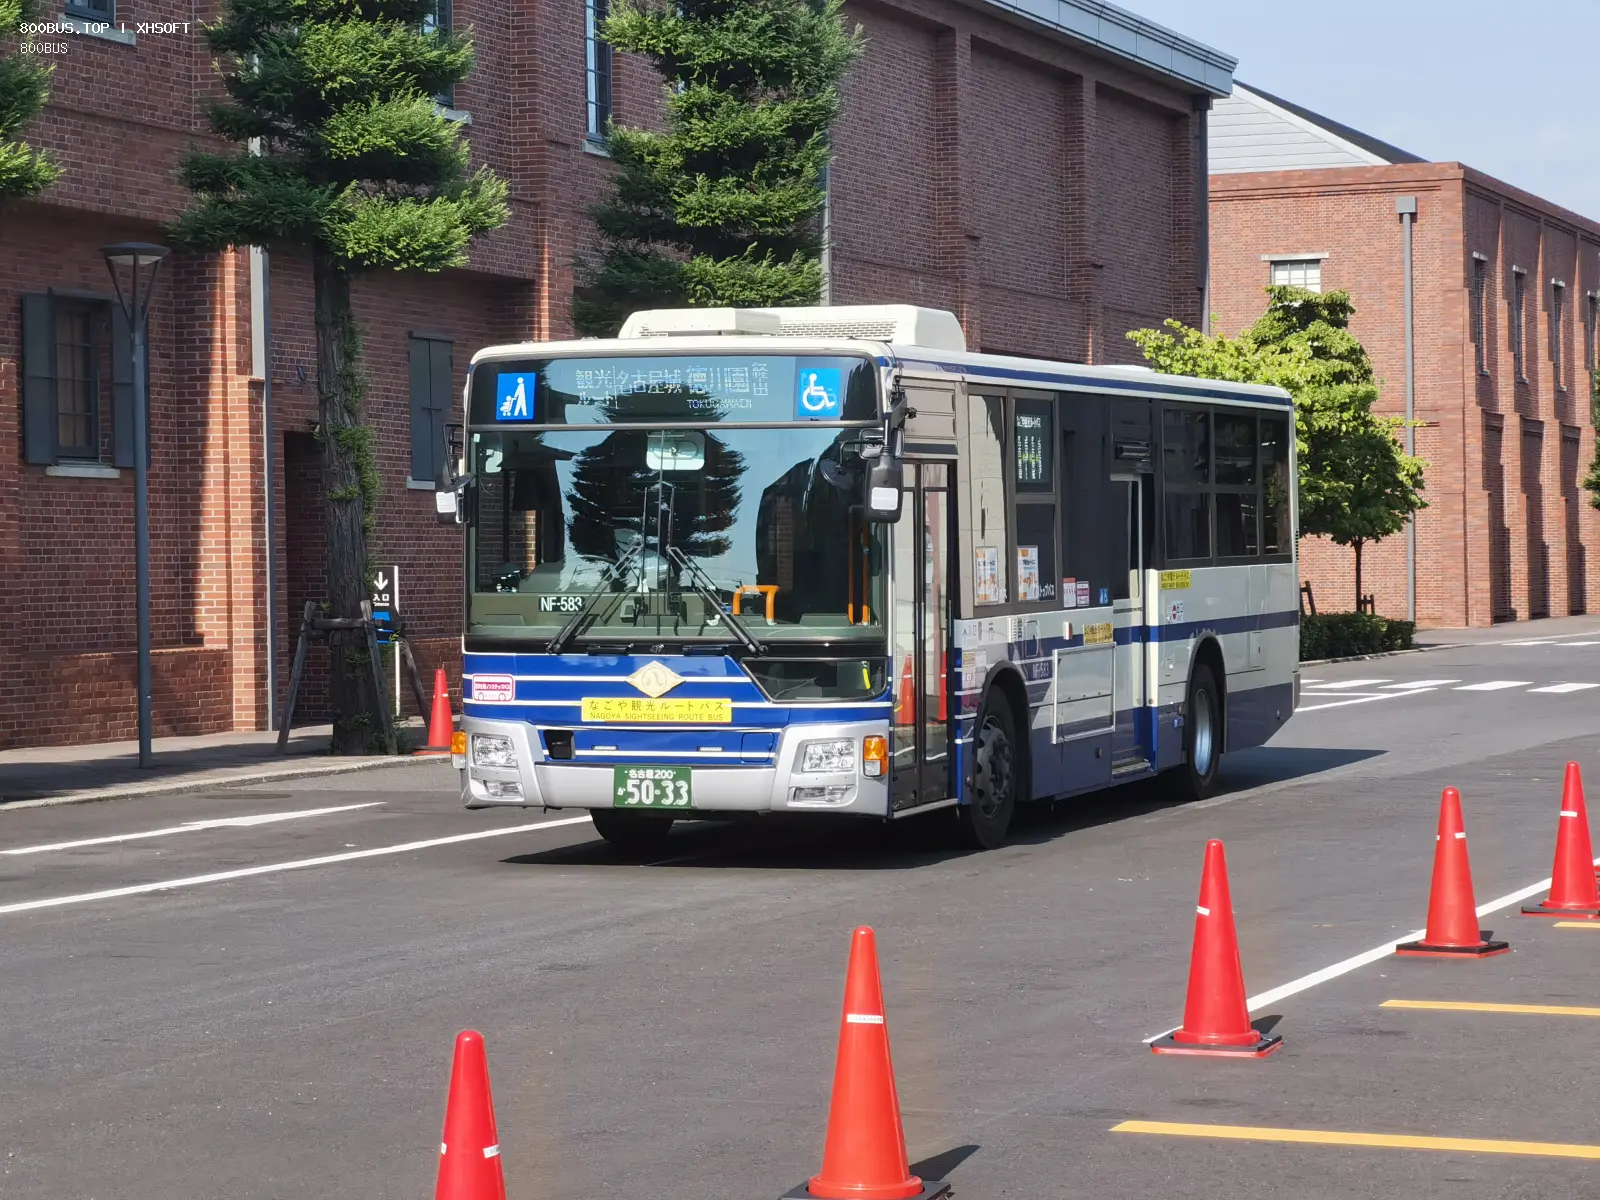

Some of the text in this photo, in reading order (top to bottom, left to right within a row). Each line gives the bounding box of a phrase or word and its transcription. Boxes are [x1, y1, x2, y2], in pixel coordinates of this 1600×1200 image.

[575, 369, 613, 389] 観光
[615, 369, 683, 394] 名古屋城
[372, 593, 390, 602] 入口
[540, 596, 583, 612] NF-583
[589, 700, 724, 711] なごや観光ルートバス
[590, 712, 724, 721] NAGOYA SIGHTSEEING ROUTE BUS
[626, 779, 689, 805] 50-33
